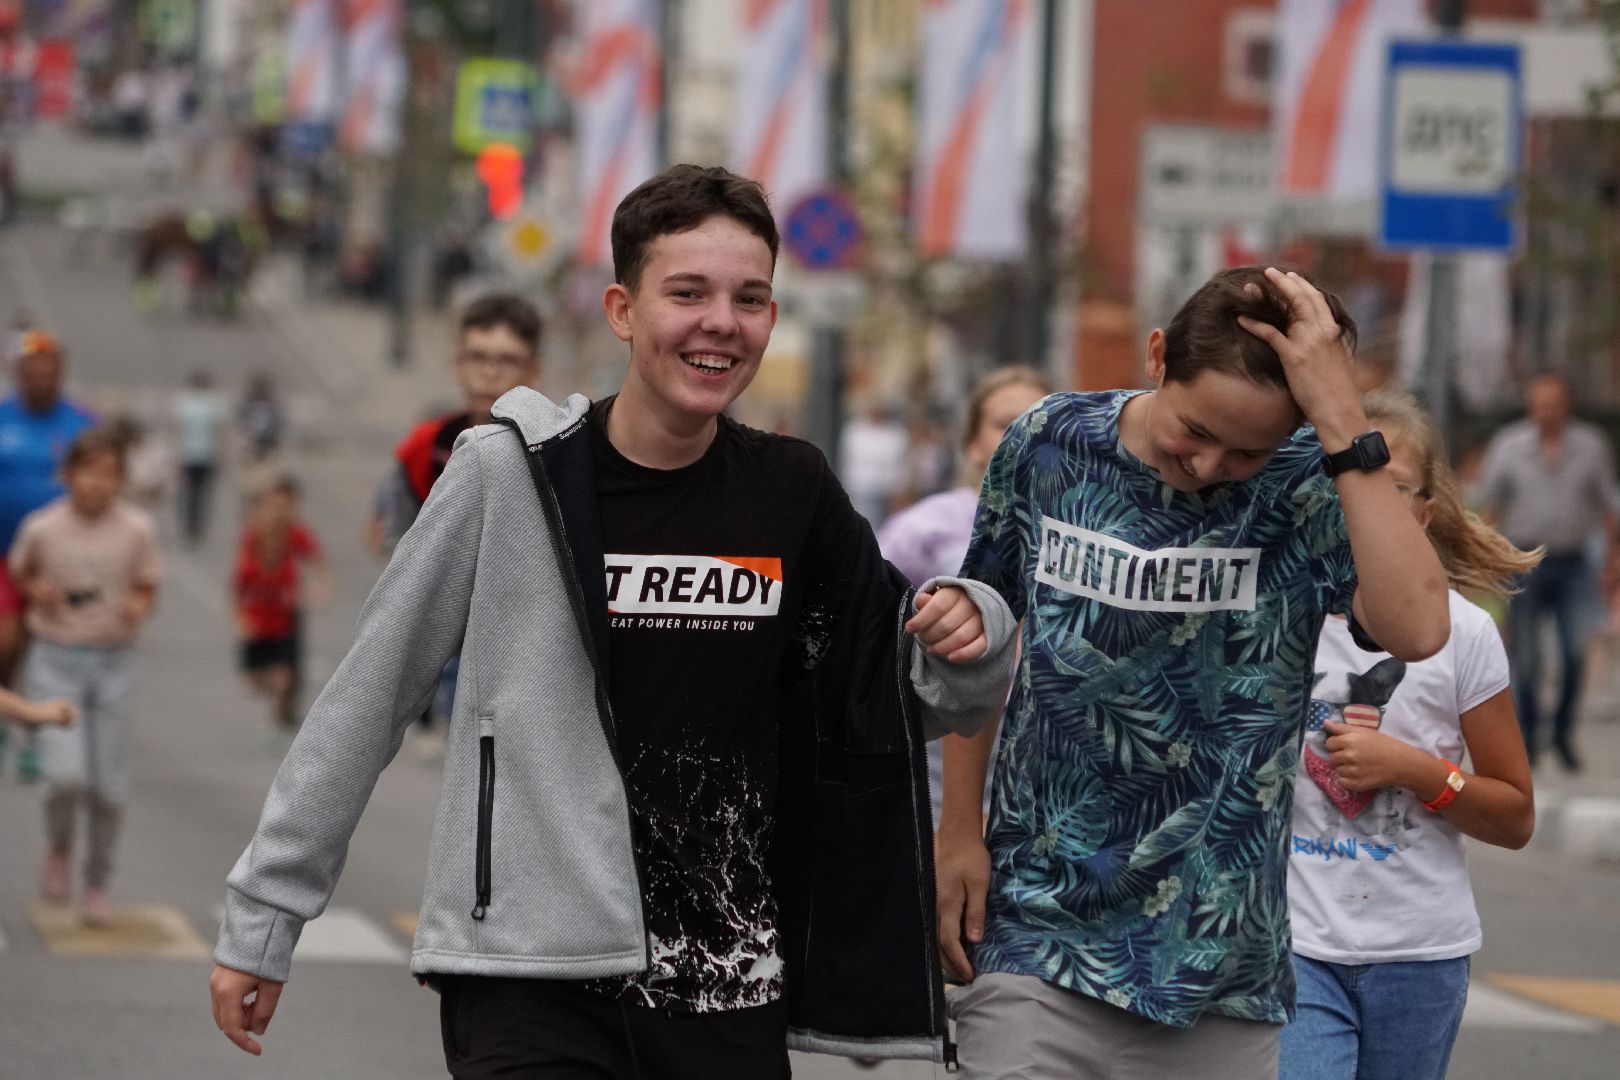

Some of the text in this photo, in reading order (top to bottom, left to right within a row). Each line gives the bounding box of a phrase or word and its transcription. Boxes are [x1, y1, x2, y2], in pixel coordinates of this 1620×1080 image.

[1043, 528, 1251, 602] CONTINENT
[639, 566, 775, 605] READY
[607, 618, 755, 632] EAT POWER INSIDE YOU
[1291, 835, 1357, 861] RMANI
